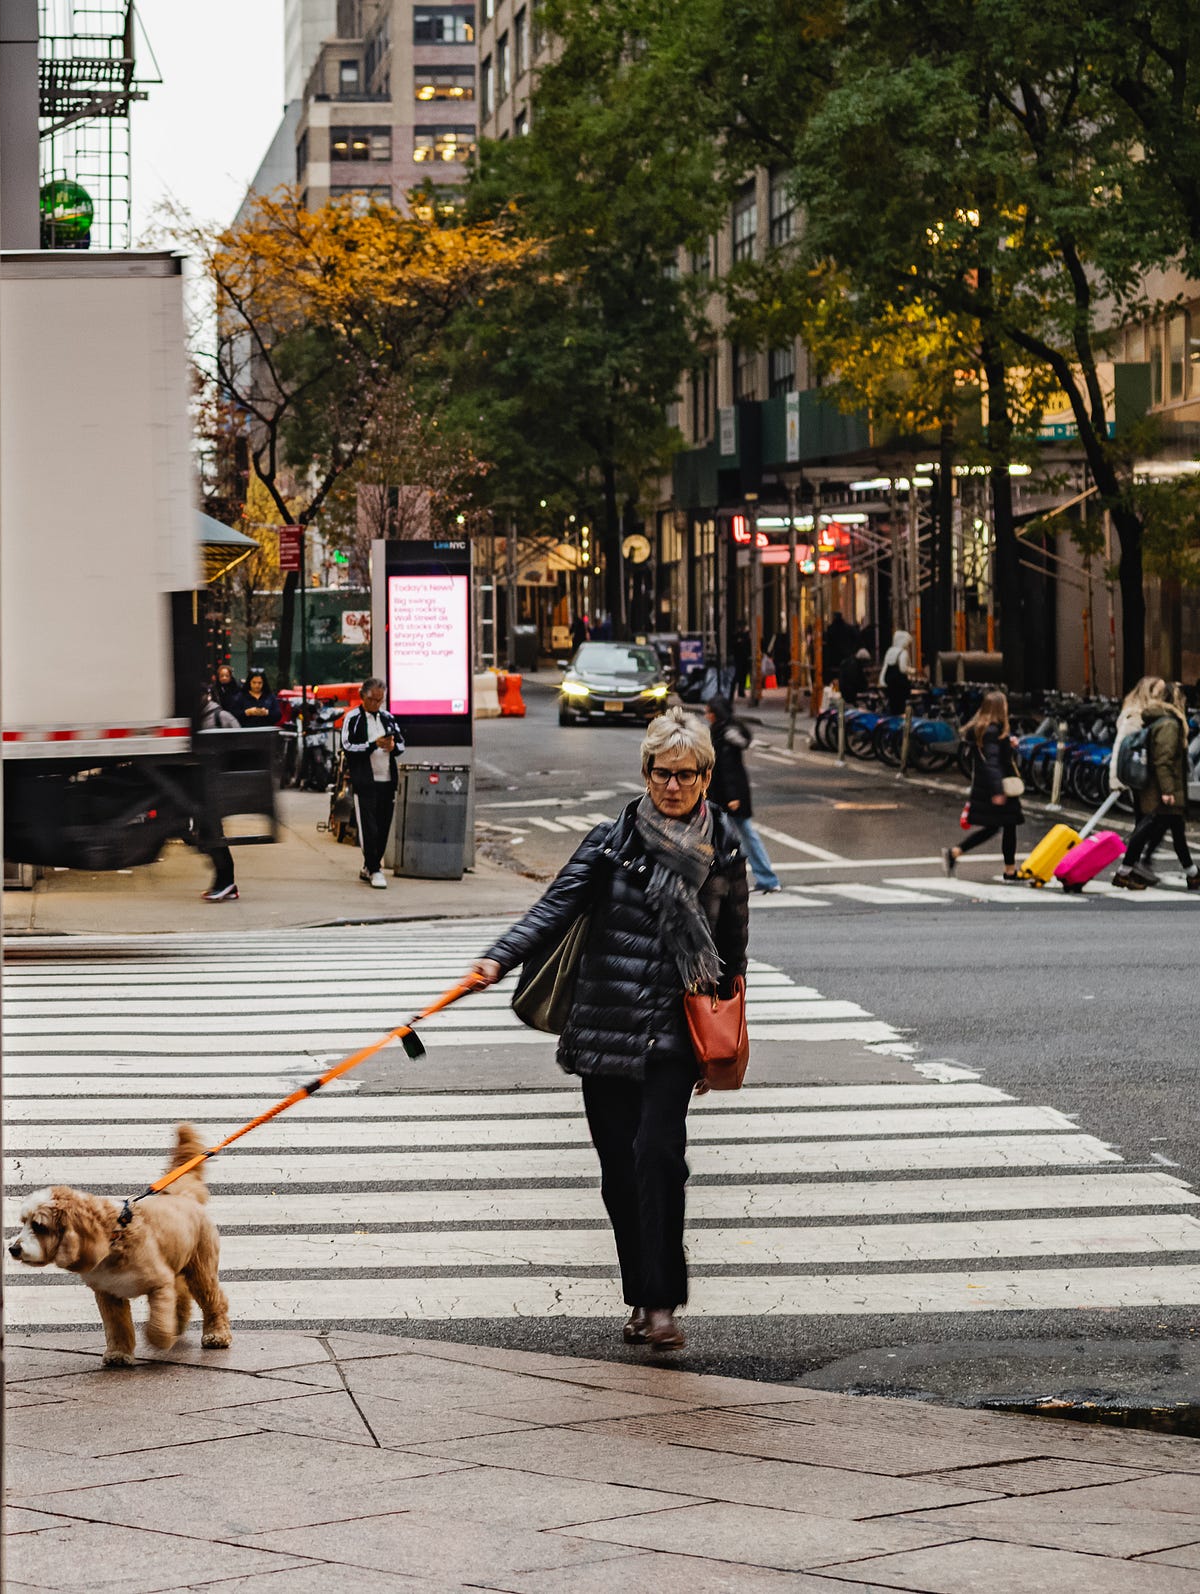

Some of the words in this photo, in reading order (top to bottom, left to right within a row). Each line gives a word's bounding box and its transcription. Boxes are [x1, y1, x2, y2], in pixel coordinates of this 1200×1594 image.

[394, 584, 428, 592] Today's
[394, 598, 407, 606] Big
[408, 598, 437, 607] swings
[394, 607, 414, 615] keep
[415, 606, 446, 615] rocking
[433, 623, 453, 632] drop
[394, 632, 424, 640] sharply
[394, 641, 425, 649] erasing
[394, 649, 430, 657] morning
